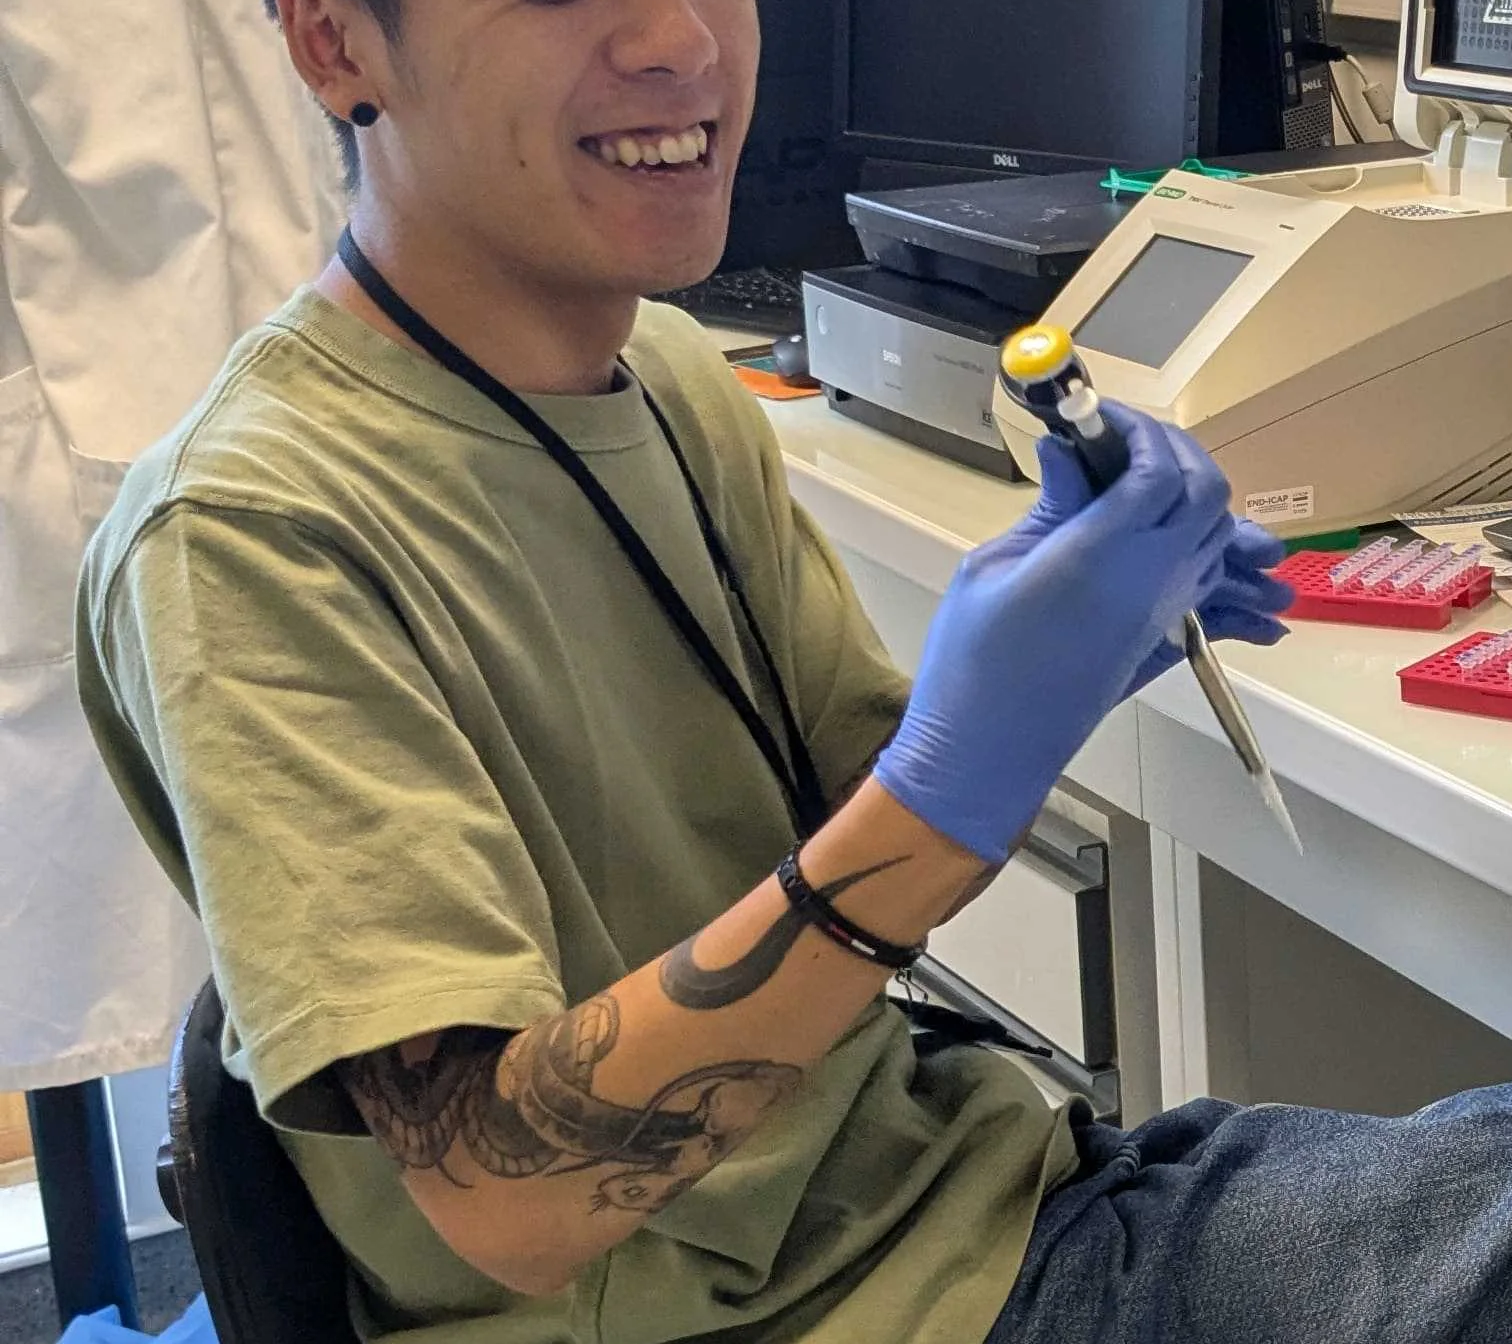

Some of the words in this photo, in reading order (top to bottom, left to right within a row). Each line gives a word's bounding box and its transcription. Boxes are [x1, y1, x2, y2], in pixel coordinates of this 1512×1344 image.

[1302, 79, 1322, 93] DELL
[993, 154, 1019, 168] DELL
[1247, 495, 1288, 507] END-ICAP
